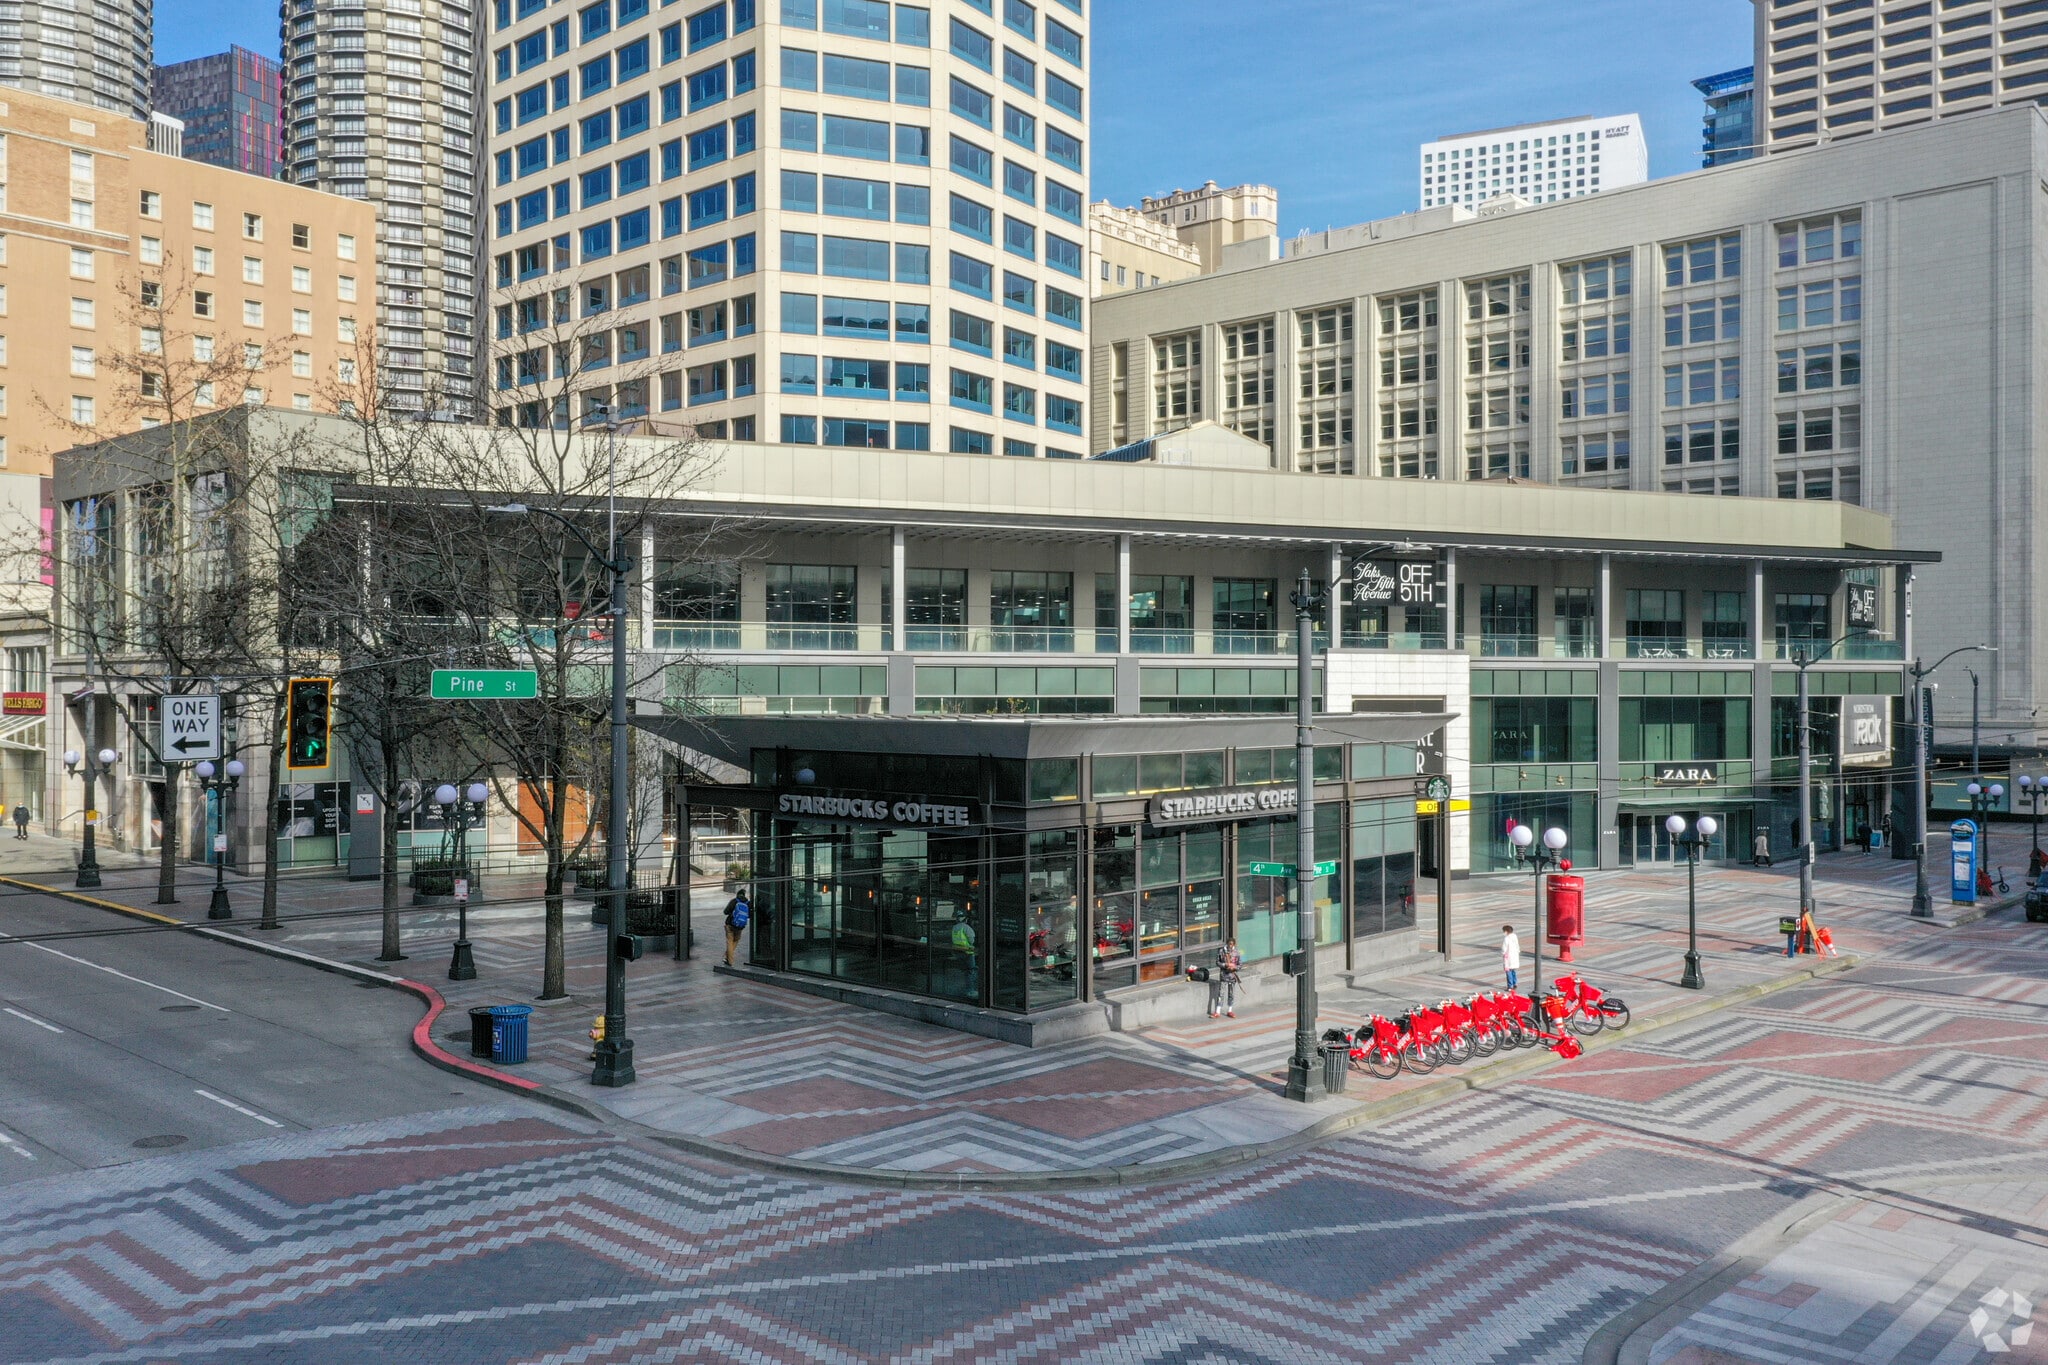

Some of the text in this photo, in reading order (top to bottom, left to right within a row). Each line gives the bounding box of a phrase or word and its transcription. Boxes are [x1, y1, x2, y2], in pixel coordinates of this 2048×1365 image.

[1605, 125, 1630, 134] HYATT
[1353, 562, 1381, 582] Saks
[1400, 564, 1432, 583] OFF
[1353, 583, 1392, 601] Avenue
[1400, 583, 1432, 602] 5TH
[450, 676, 516, 692] Pine St
[172, 701, 209, 716] ONE
[172, 718, 209, 733] WAY
[1663, 768, 1713, 780] ZARA
[779, 794, 969, 826] STARBUCKS COFFEE
[1160, 792, 1255, 818] STARBUCKS
